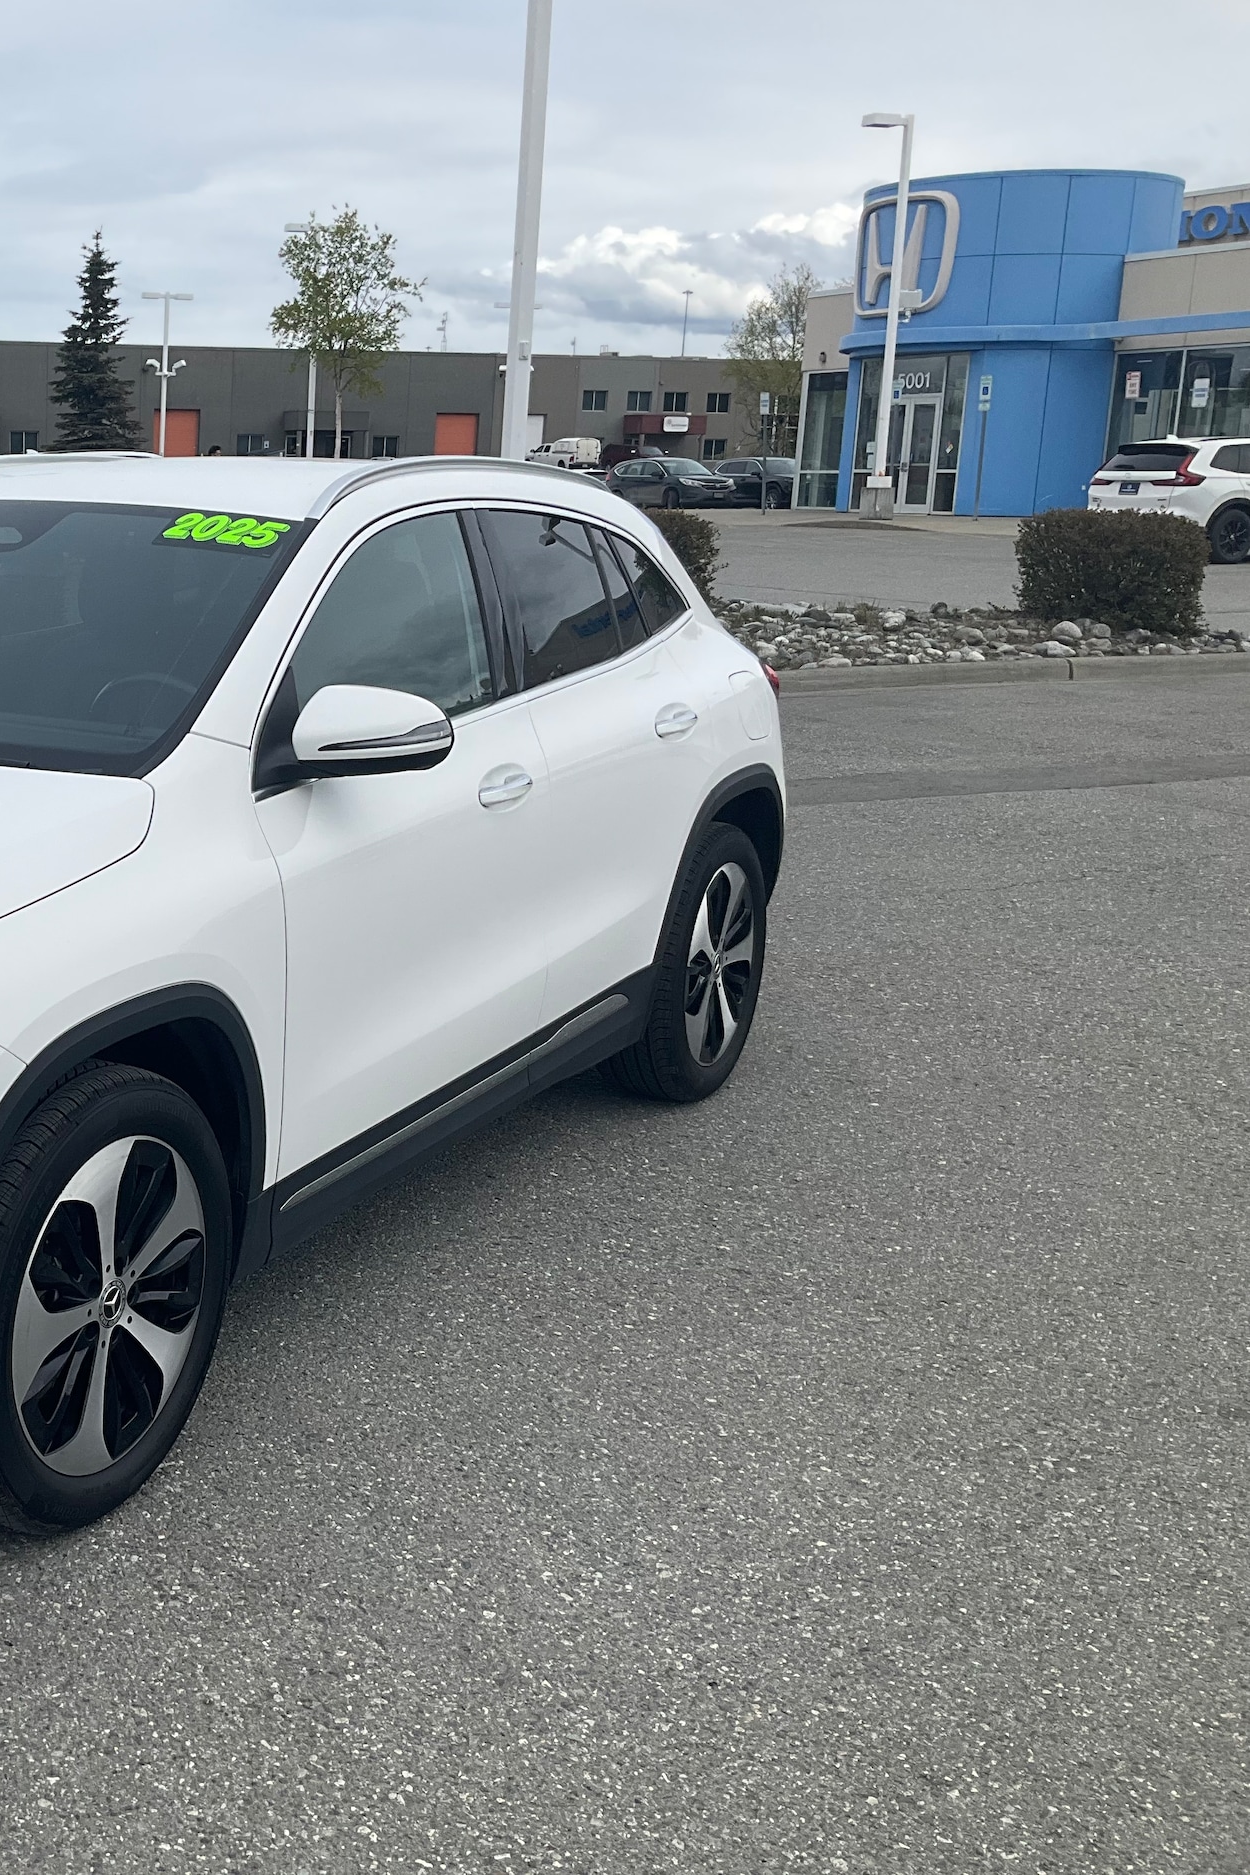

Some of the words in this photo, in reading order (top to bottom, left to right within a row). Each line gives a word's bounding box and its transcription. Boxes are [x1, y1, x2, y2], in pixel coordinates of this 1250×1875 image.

[1179, 202, 1250, 241] ON
[898, 372, 931, 389] 5001
[162, 511, 291, 549] 2025
